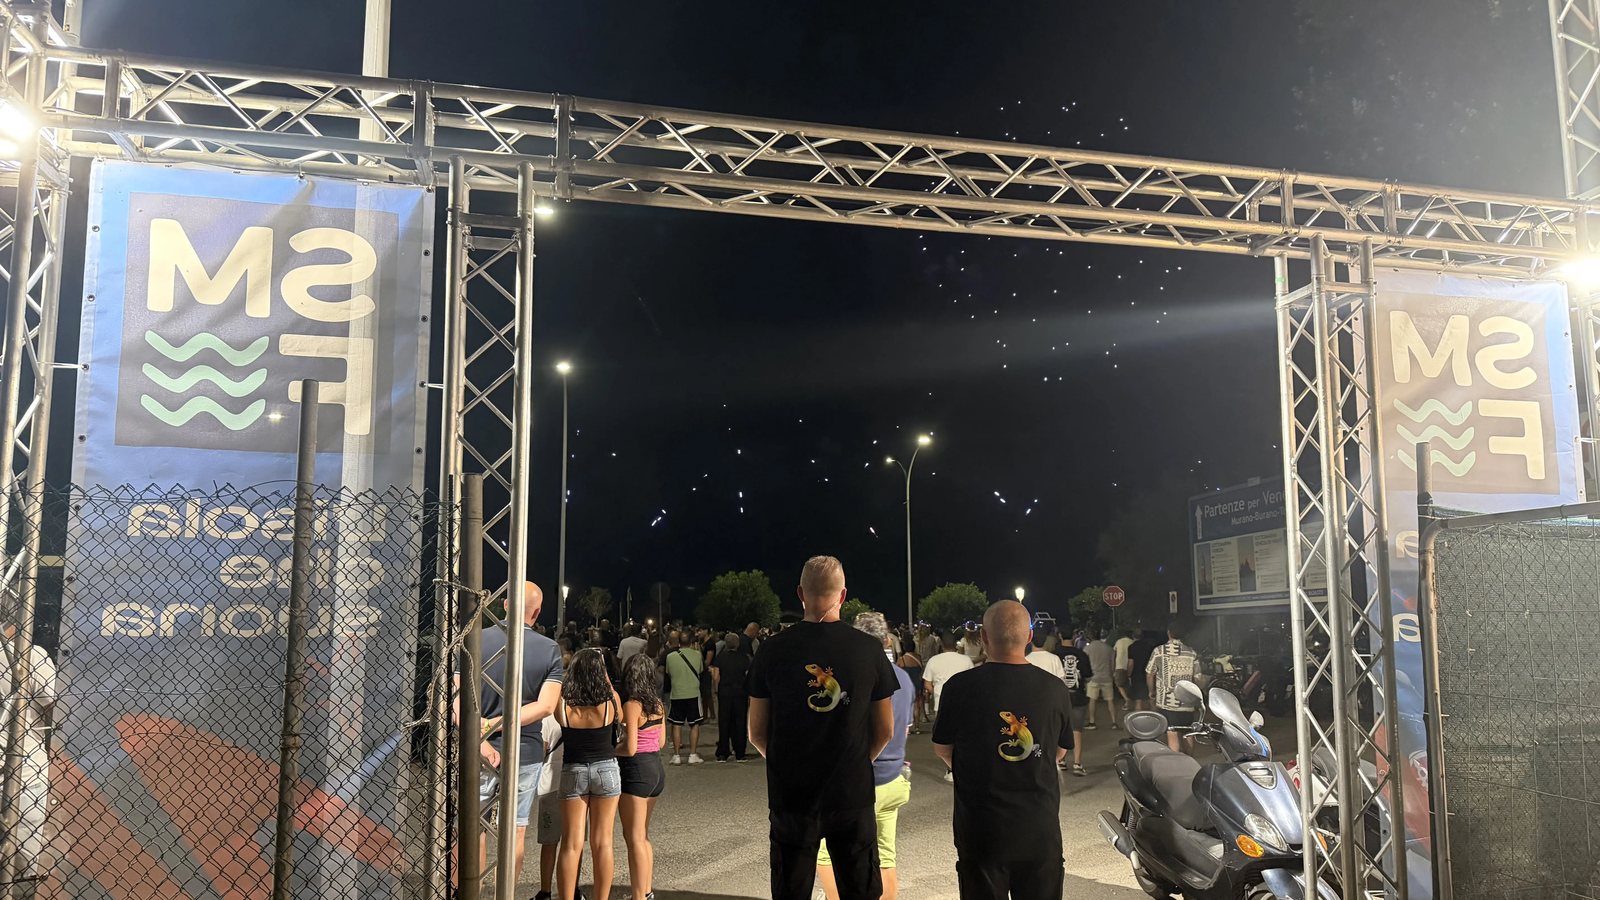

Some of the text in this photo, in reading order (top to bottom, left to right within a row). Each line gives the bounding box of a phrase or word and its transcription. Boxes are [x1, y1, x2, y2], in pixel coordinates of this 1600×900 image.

[1204, 499, 1245, 518] Partenze
[1247, 498, 1260, 512] per
[1104, 592, 1123, 601] STOP
